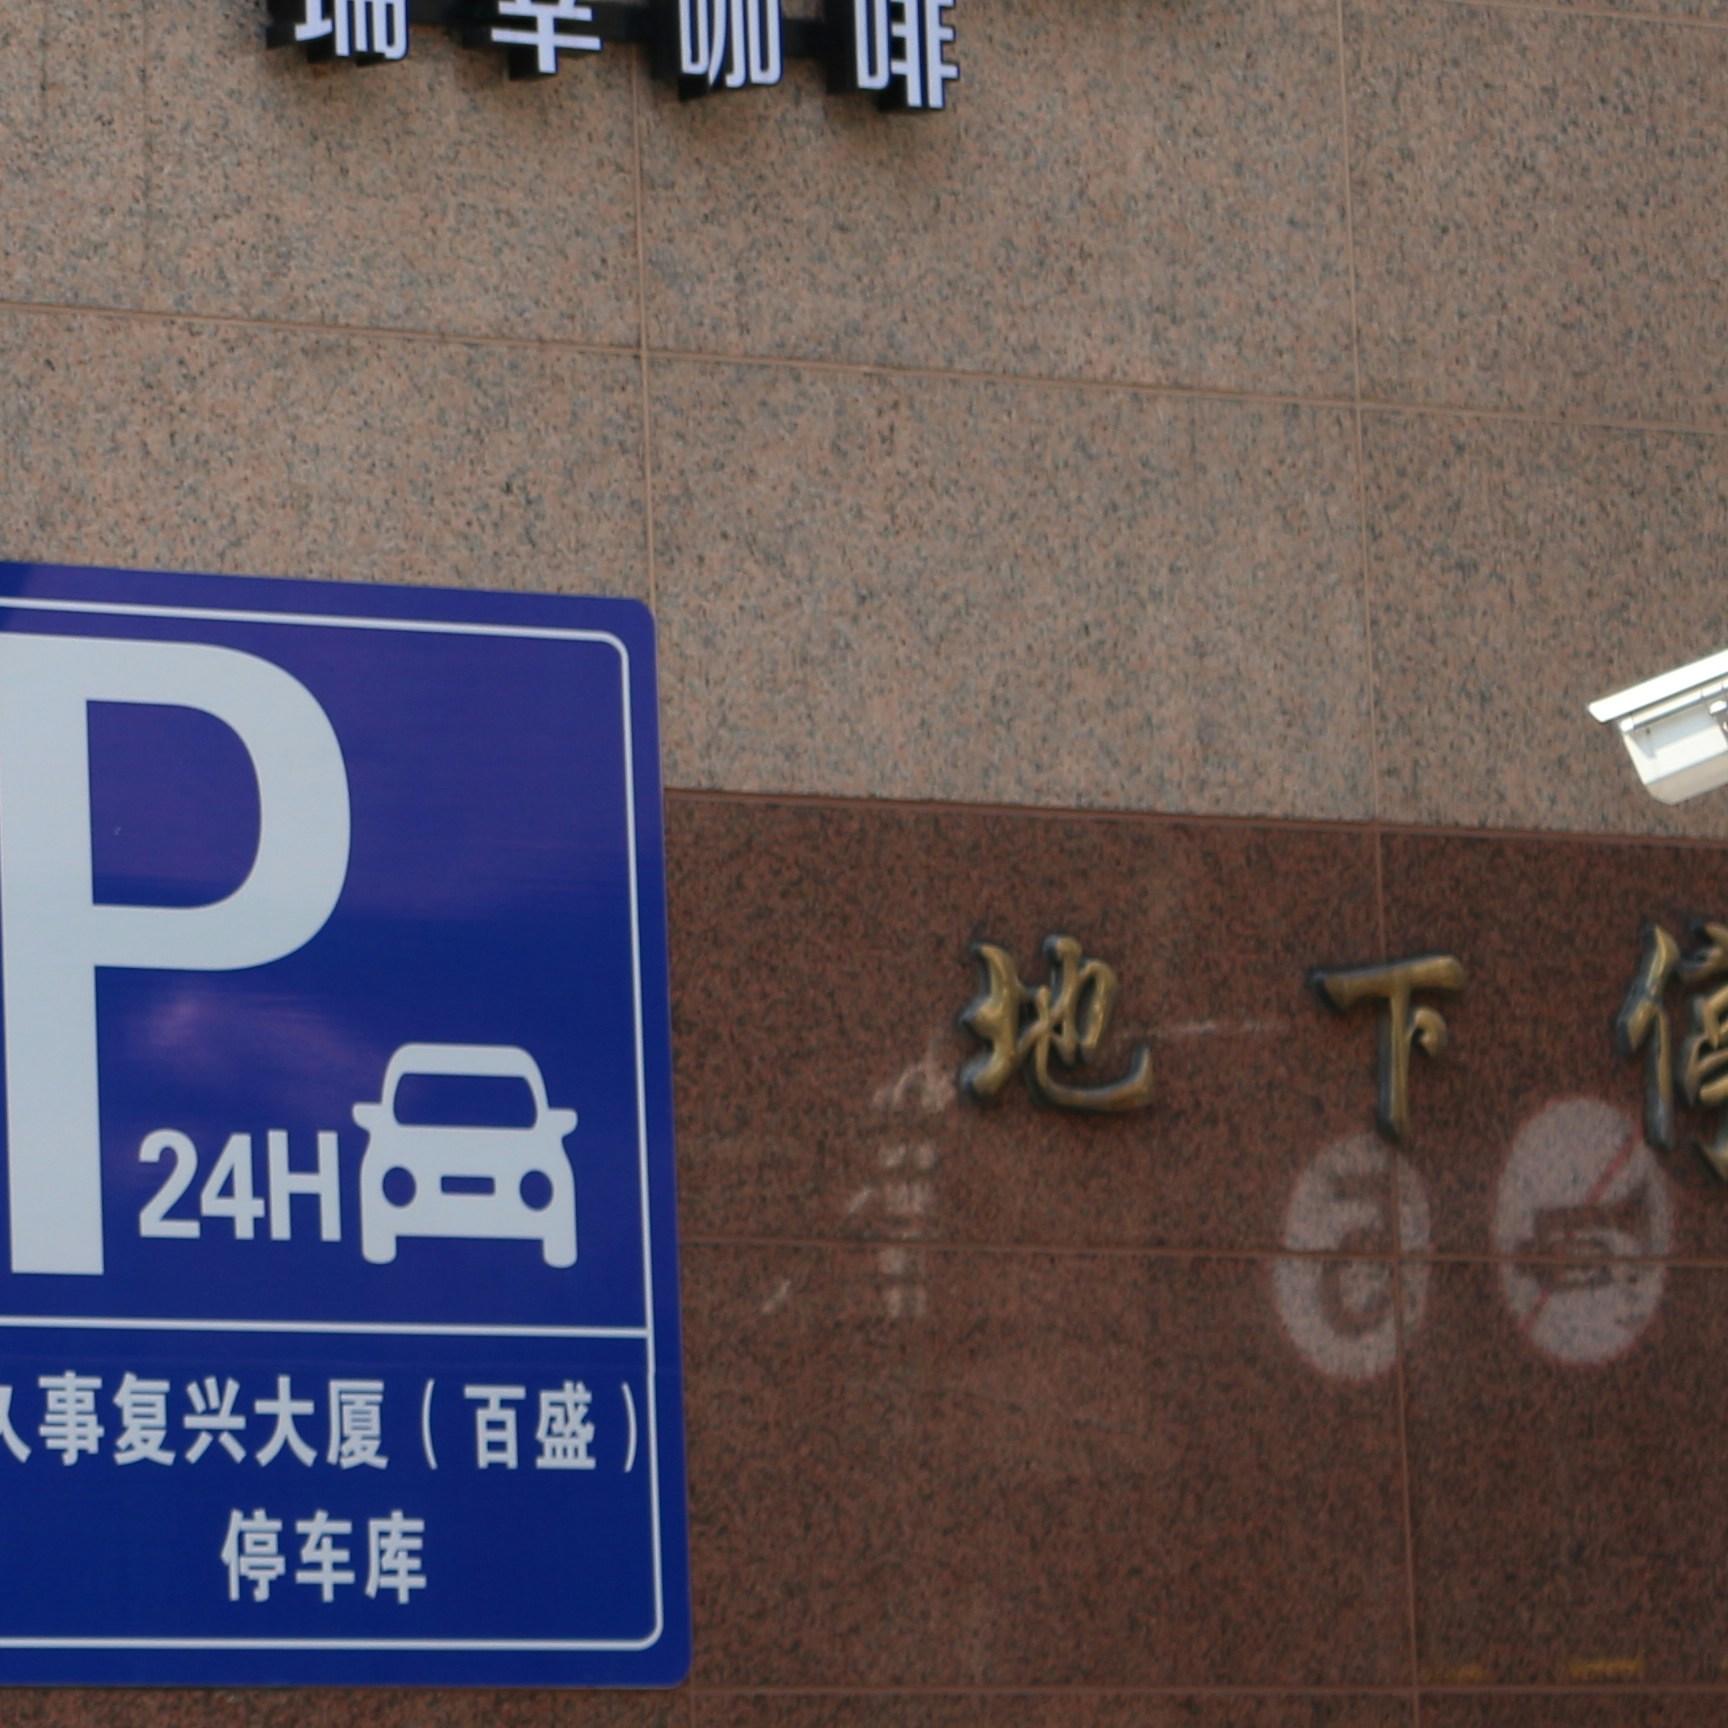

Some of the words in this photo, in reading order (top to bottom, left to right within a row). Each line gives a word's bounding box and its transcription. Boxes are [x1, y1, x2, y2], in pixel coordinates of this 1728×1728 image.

[138, 1128, 341, 1243] 24H
[221, 1509, 428, 1604] 停车库
